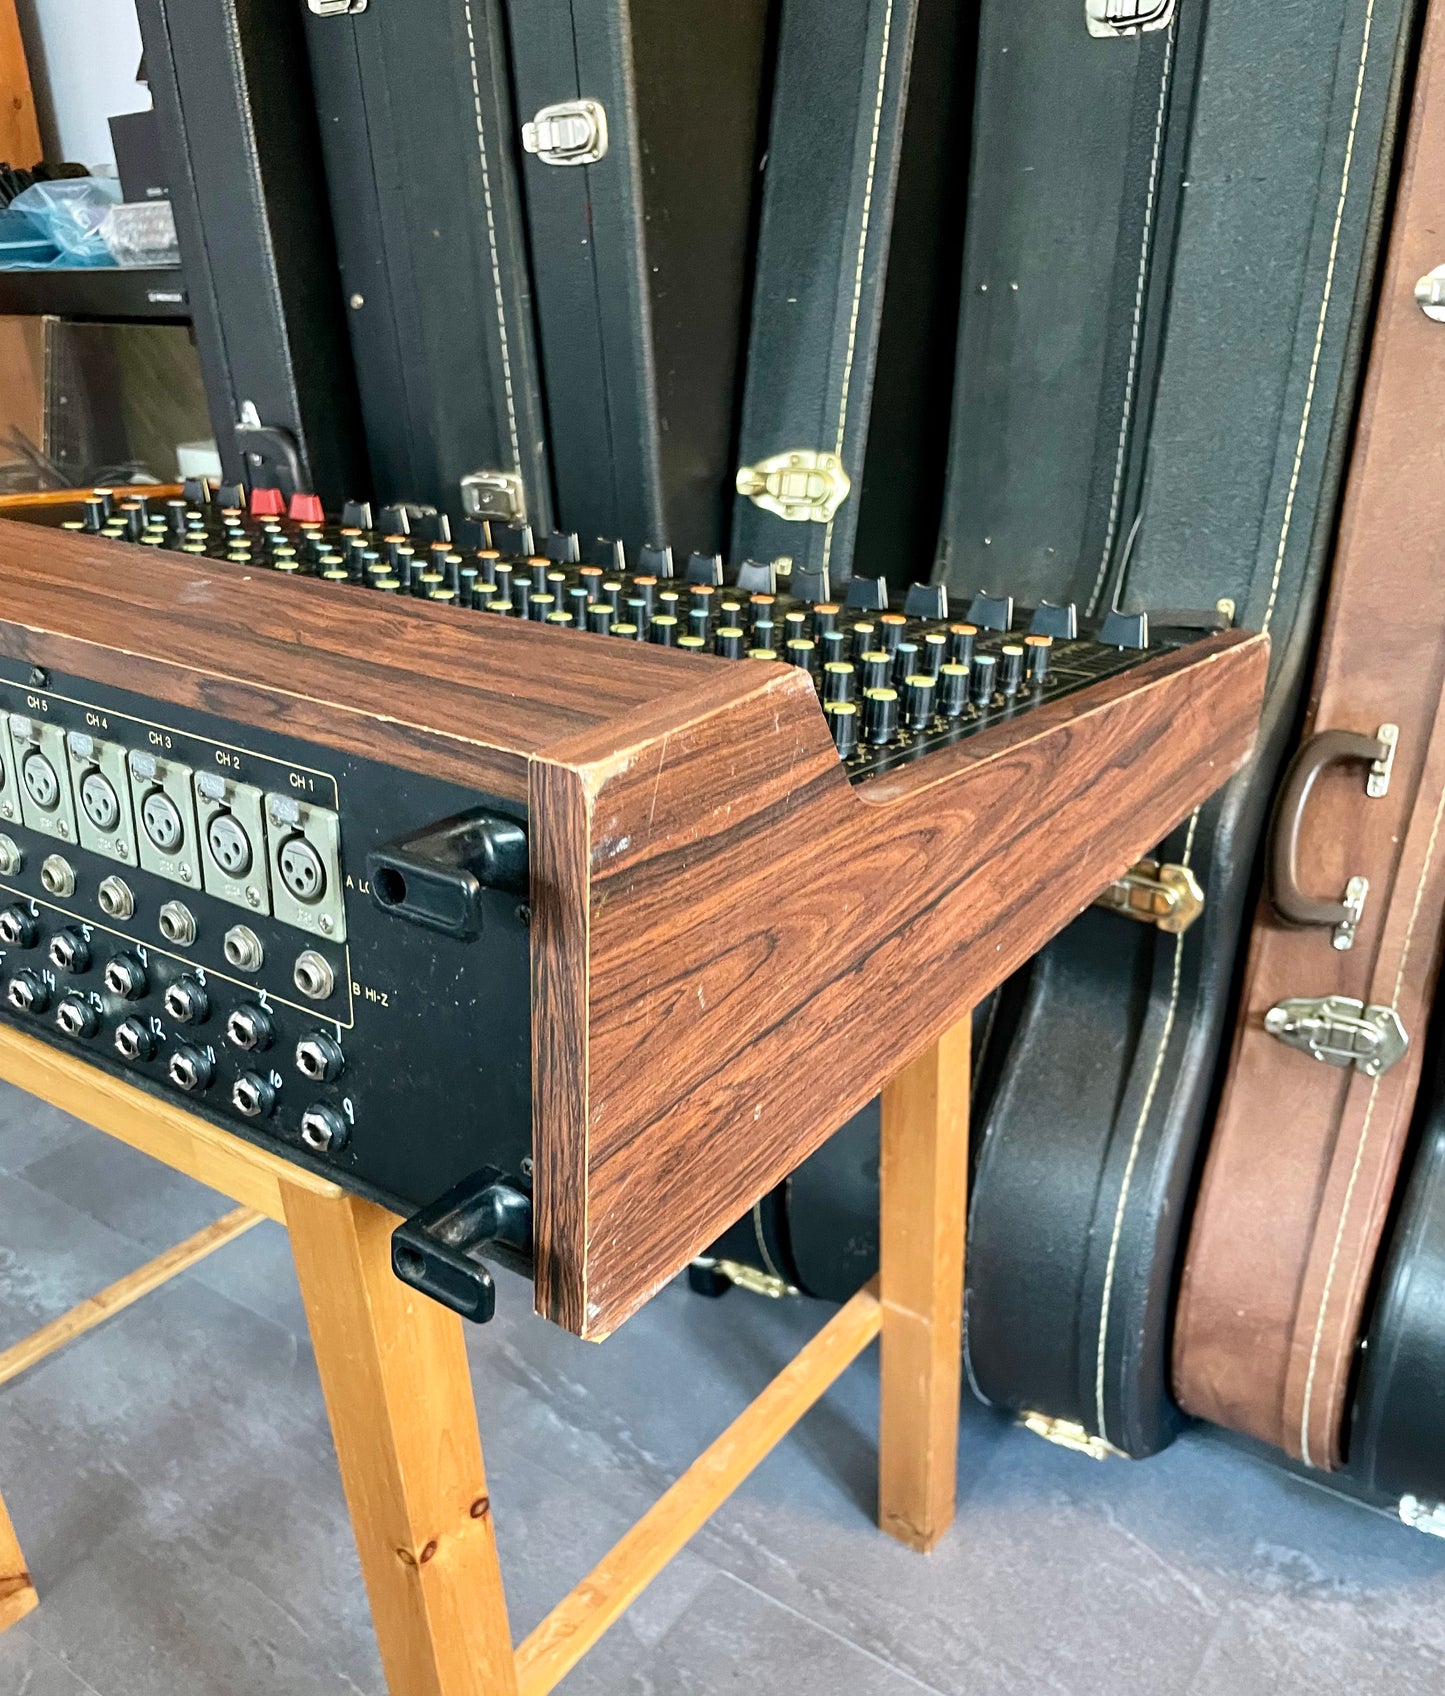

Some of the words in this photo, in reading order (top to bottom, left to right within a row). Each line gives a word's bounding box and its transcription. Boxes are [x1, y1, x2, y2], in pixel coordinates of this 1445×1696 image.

[27, 695, 40, 710] CH
[42, 701, 48, 712] 5
[86, 713, 99, 727] CH
[102, 718, 108, 730] 4
[149, 731, 163, 747] CH
[165, 737, 172, 749] 3
[215, 750, 231, 768] CH
[233, 757, 240, 770] 2
[289, 772, 306, 790] CH
[308, 779, 314, 792] 1
[346, 875, 354, 889] A
[30, 899, 40, 917] 6
[82, 923, 95, 942] 5
[42, 969, 56, 992] 14
[195, 967, 207, 987] 3
[90, 991, 104, 1013] 13
[259, 988, 274, 1014] 2
[352, 982, 361, 996] B
[365, 986, 389, 1007] HI-Z
[150, 1016, 167, 1040] 12
[207, 1045, 216, 1064] 11
[270, 1069, 283, 1088] 10
[343, 1097, 355, 1125] 9
